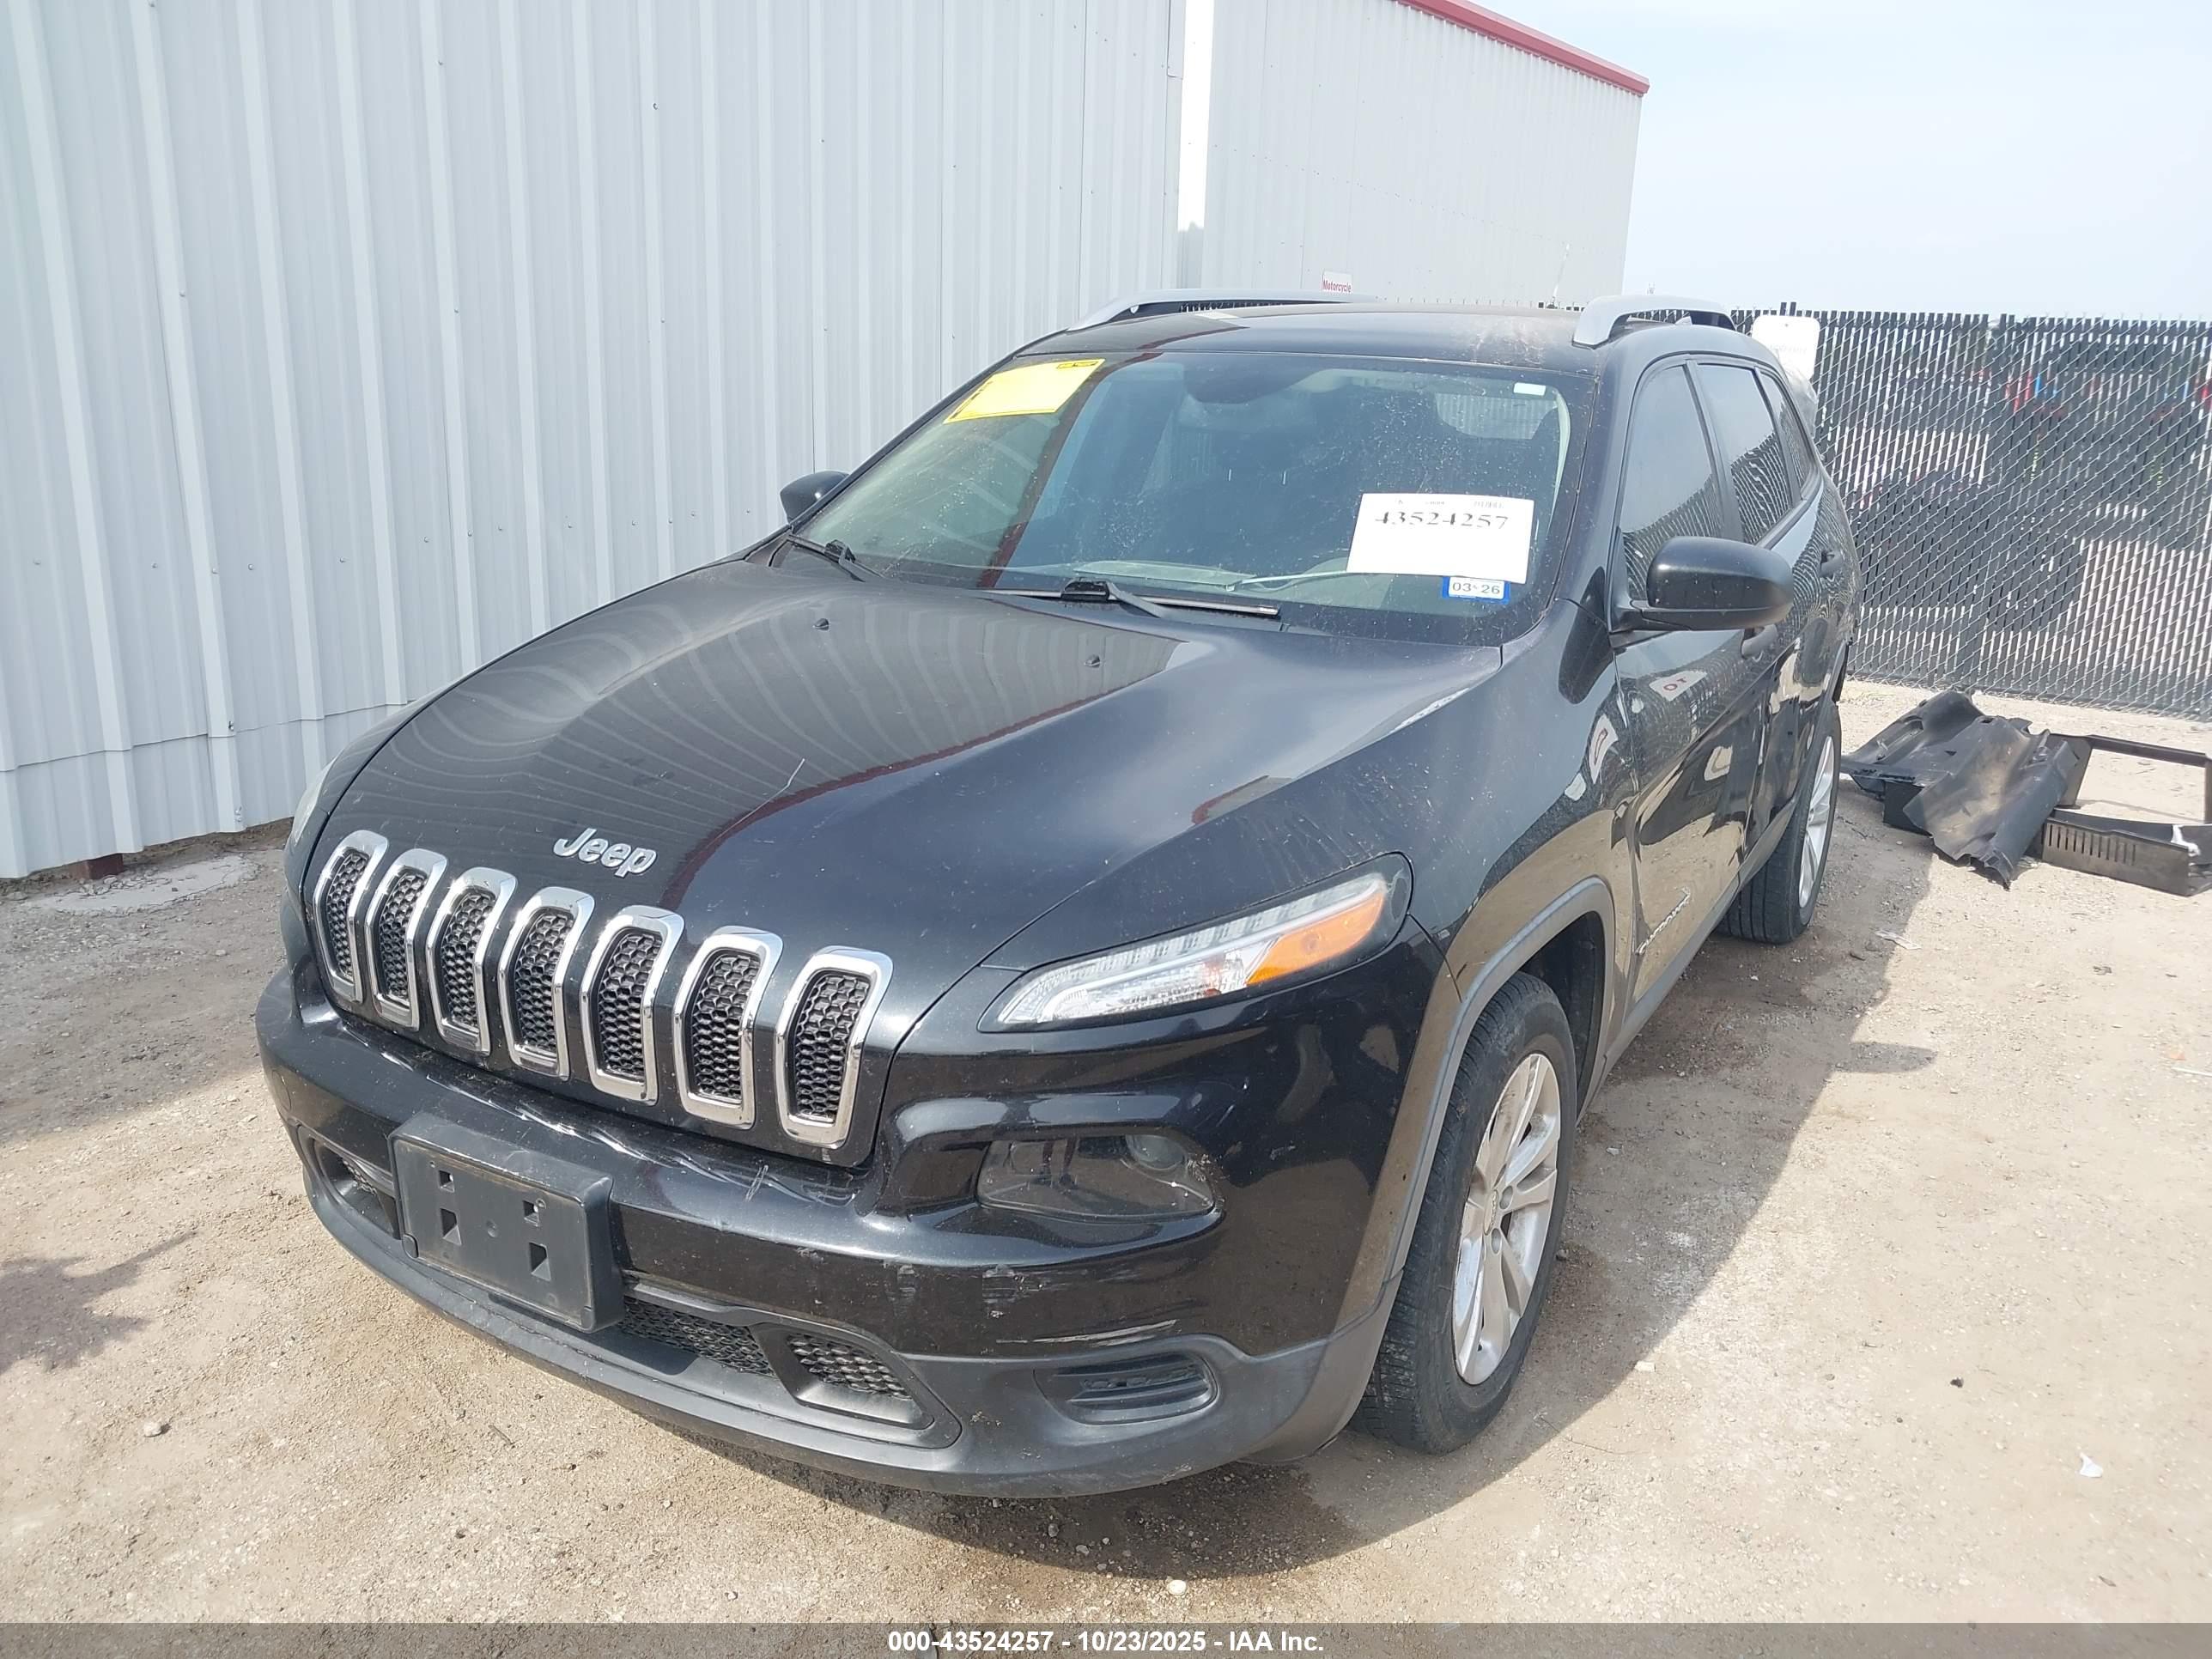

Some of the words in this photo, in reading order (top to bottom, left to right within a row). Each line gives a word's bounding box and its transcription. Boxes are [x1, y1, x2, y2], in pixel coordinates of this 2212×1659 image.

[1322, 279, 1352, 293] Motorcycle
[1375, 511, 1509, 530] 43524257
[553, 827, 658, 878] Jeep
